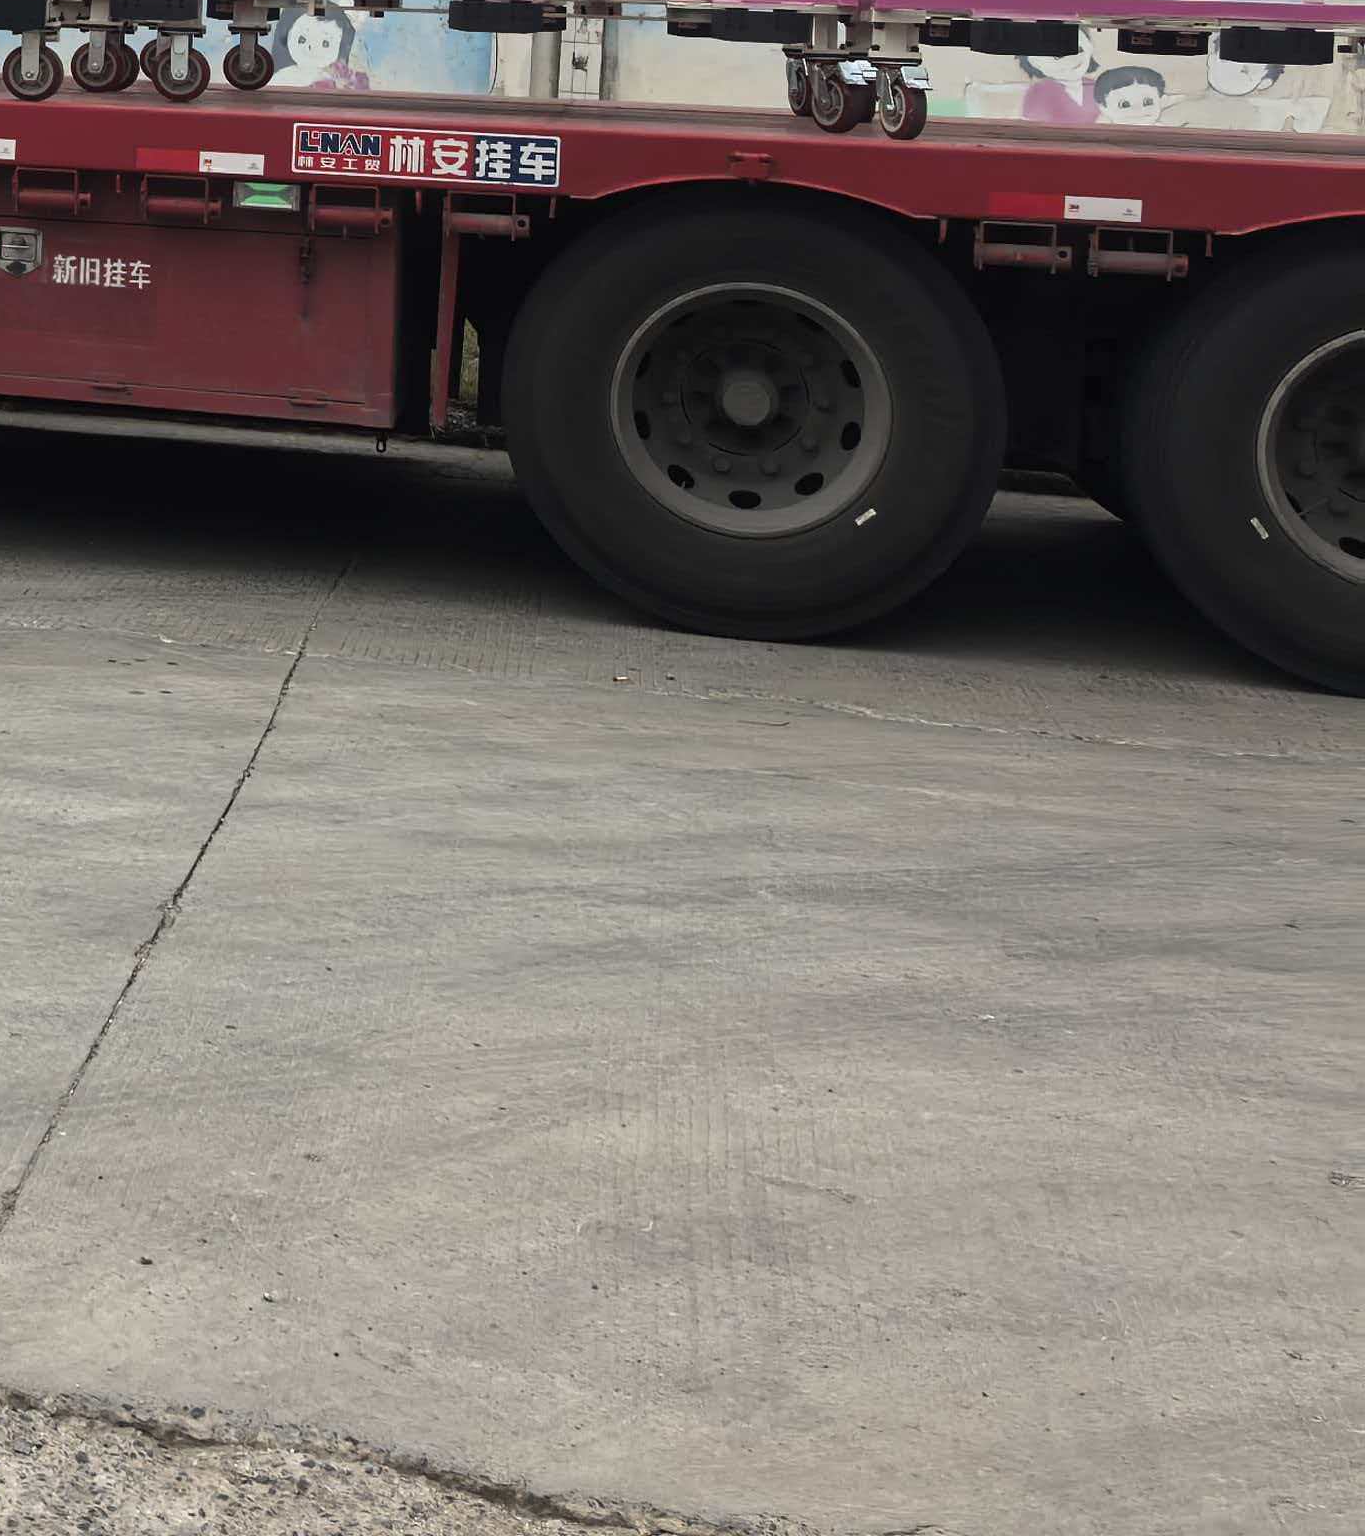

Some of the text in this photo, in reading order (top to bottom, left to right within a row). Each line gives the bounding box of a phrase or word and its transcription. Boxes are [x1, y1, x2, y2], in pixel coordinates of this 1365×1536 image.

[297, 156, 381, 173] 林安工贸
[388, 134, 557, 182] 林安挂车
[51, 253, 152, 290] 新旧挂车
